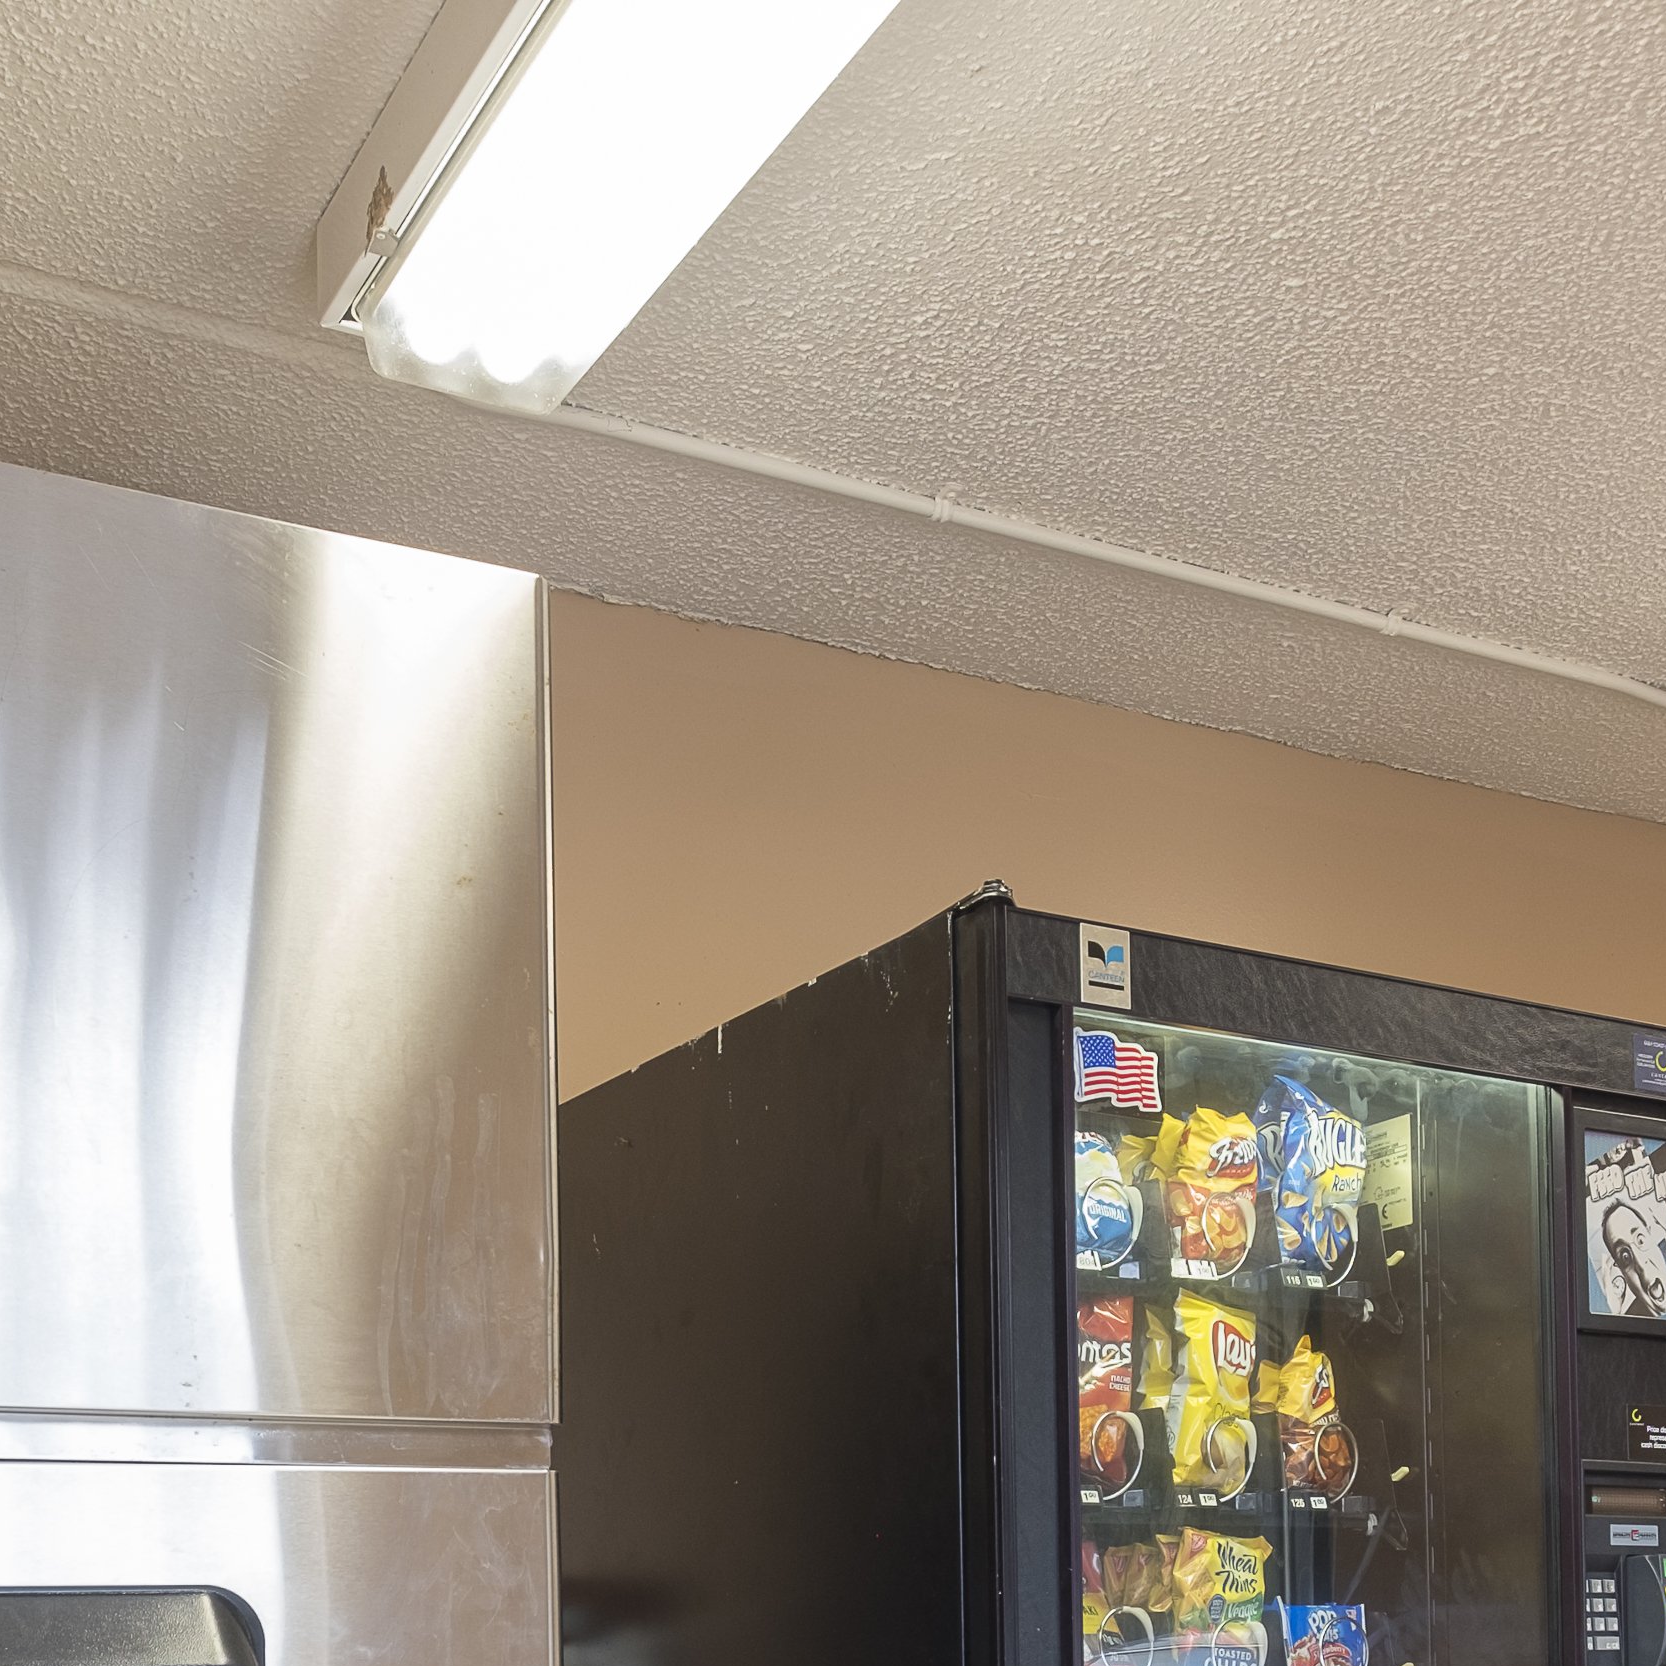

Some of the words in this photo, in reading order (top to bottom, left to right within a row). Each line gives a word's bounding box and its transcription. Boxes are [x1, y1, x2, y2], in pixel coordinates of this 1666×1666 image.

[1332, 1172, 1363, 1192] Ranch
[1589, 1164, 1624, 1202] FEED
[1624, 1164, 1654, 1200] THE
[1216, 1540, 1259, 1576] Wheat
[1215, 1570, 1258, 1594] Thins
[1214, 1647, 1252, 1661] TOASTED
